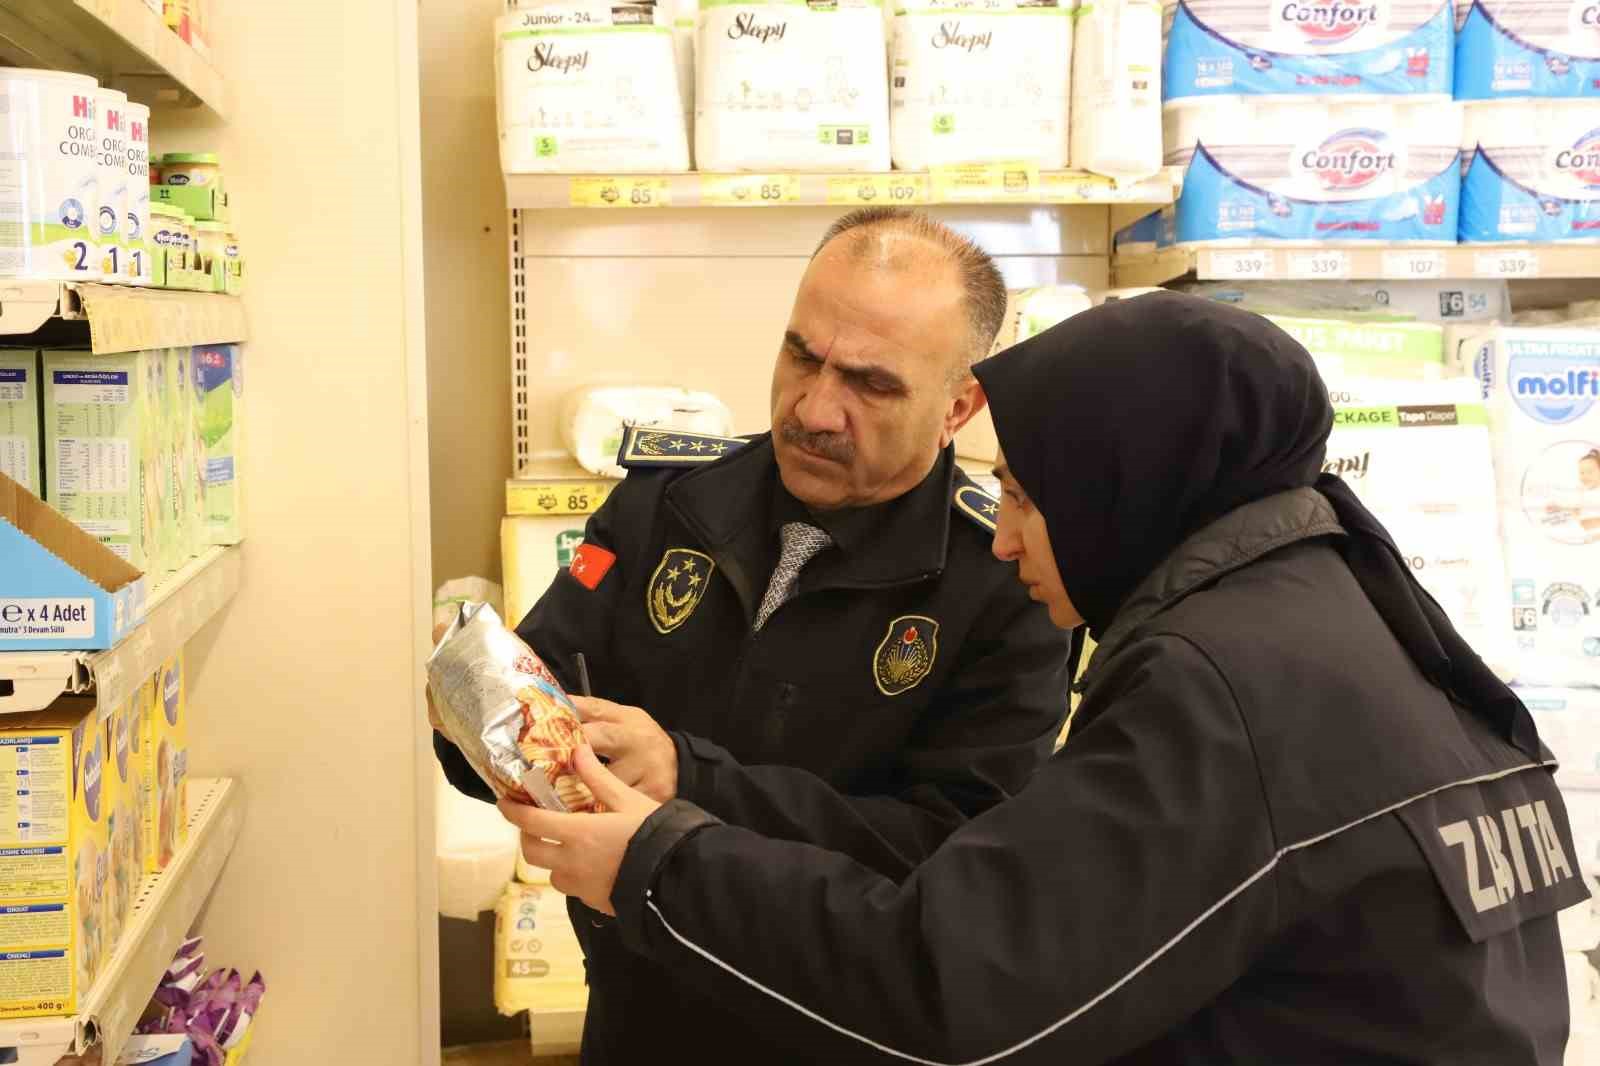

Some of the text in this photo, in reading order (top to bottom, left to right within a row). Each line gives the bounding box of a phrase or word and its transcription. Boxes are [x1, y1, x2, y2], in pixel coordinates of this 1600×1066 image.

[522, 12, 564, 27] Junior
[1281, 2, 1377, 28] Confort
[727, 11, 787, 44] Sleepy
[931, 20, 993, 54] Sleepy
[527, 42, 589, 74] Sleepy
[1301, 148, 1395, 175] Confort
[630, 188, 650, 204] 85
[760, 184, 781, 200] 85
[888, 186, 914, 200] 109
[73, 241, 88, 271] 2
[108, 246, 118, 274] 1
[132, 250, 142, 277] 1
[1234, 259, 1263, 273] 339
[1311, 259, 1339, 273] 339
[1409, 260, 1433, 273] 107
[1499, 259, 1527, 273] 339
[1450, 293, 1463, 312] 6
[1334, 410, 1392, 424] CKAGE
[1399, 411, 1426, 424] Tape
[1321, 451, 1371, 480] epy
[567, 495, 588, 510] 85
[27, 608, 35, 621] x
[40, 604, 48, 621] 4
[53, 604, 86, 621] Adet
[1438, 799, 1574, 913] ZBITA
